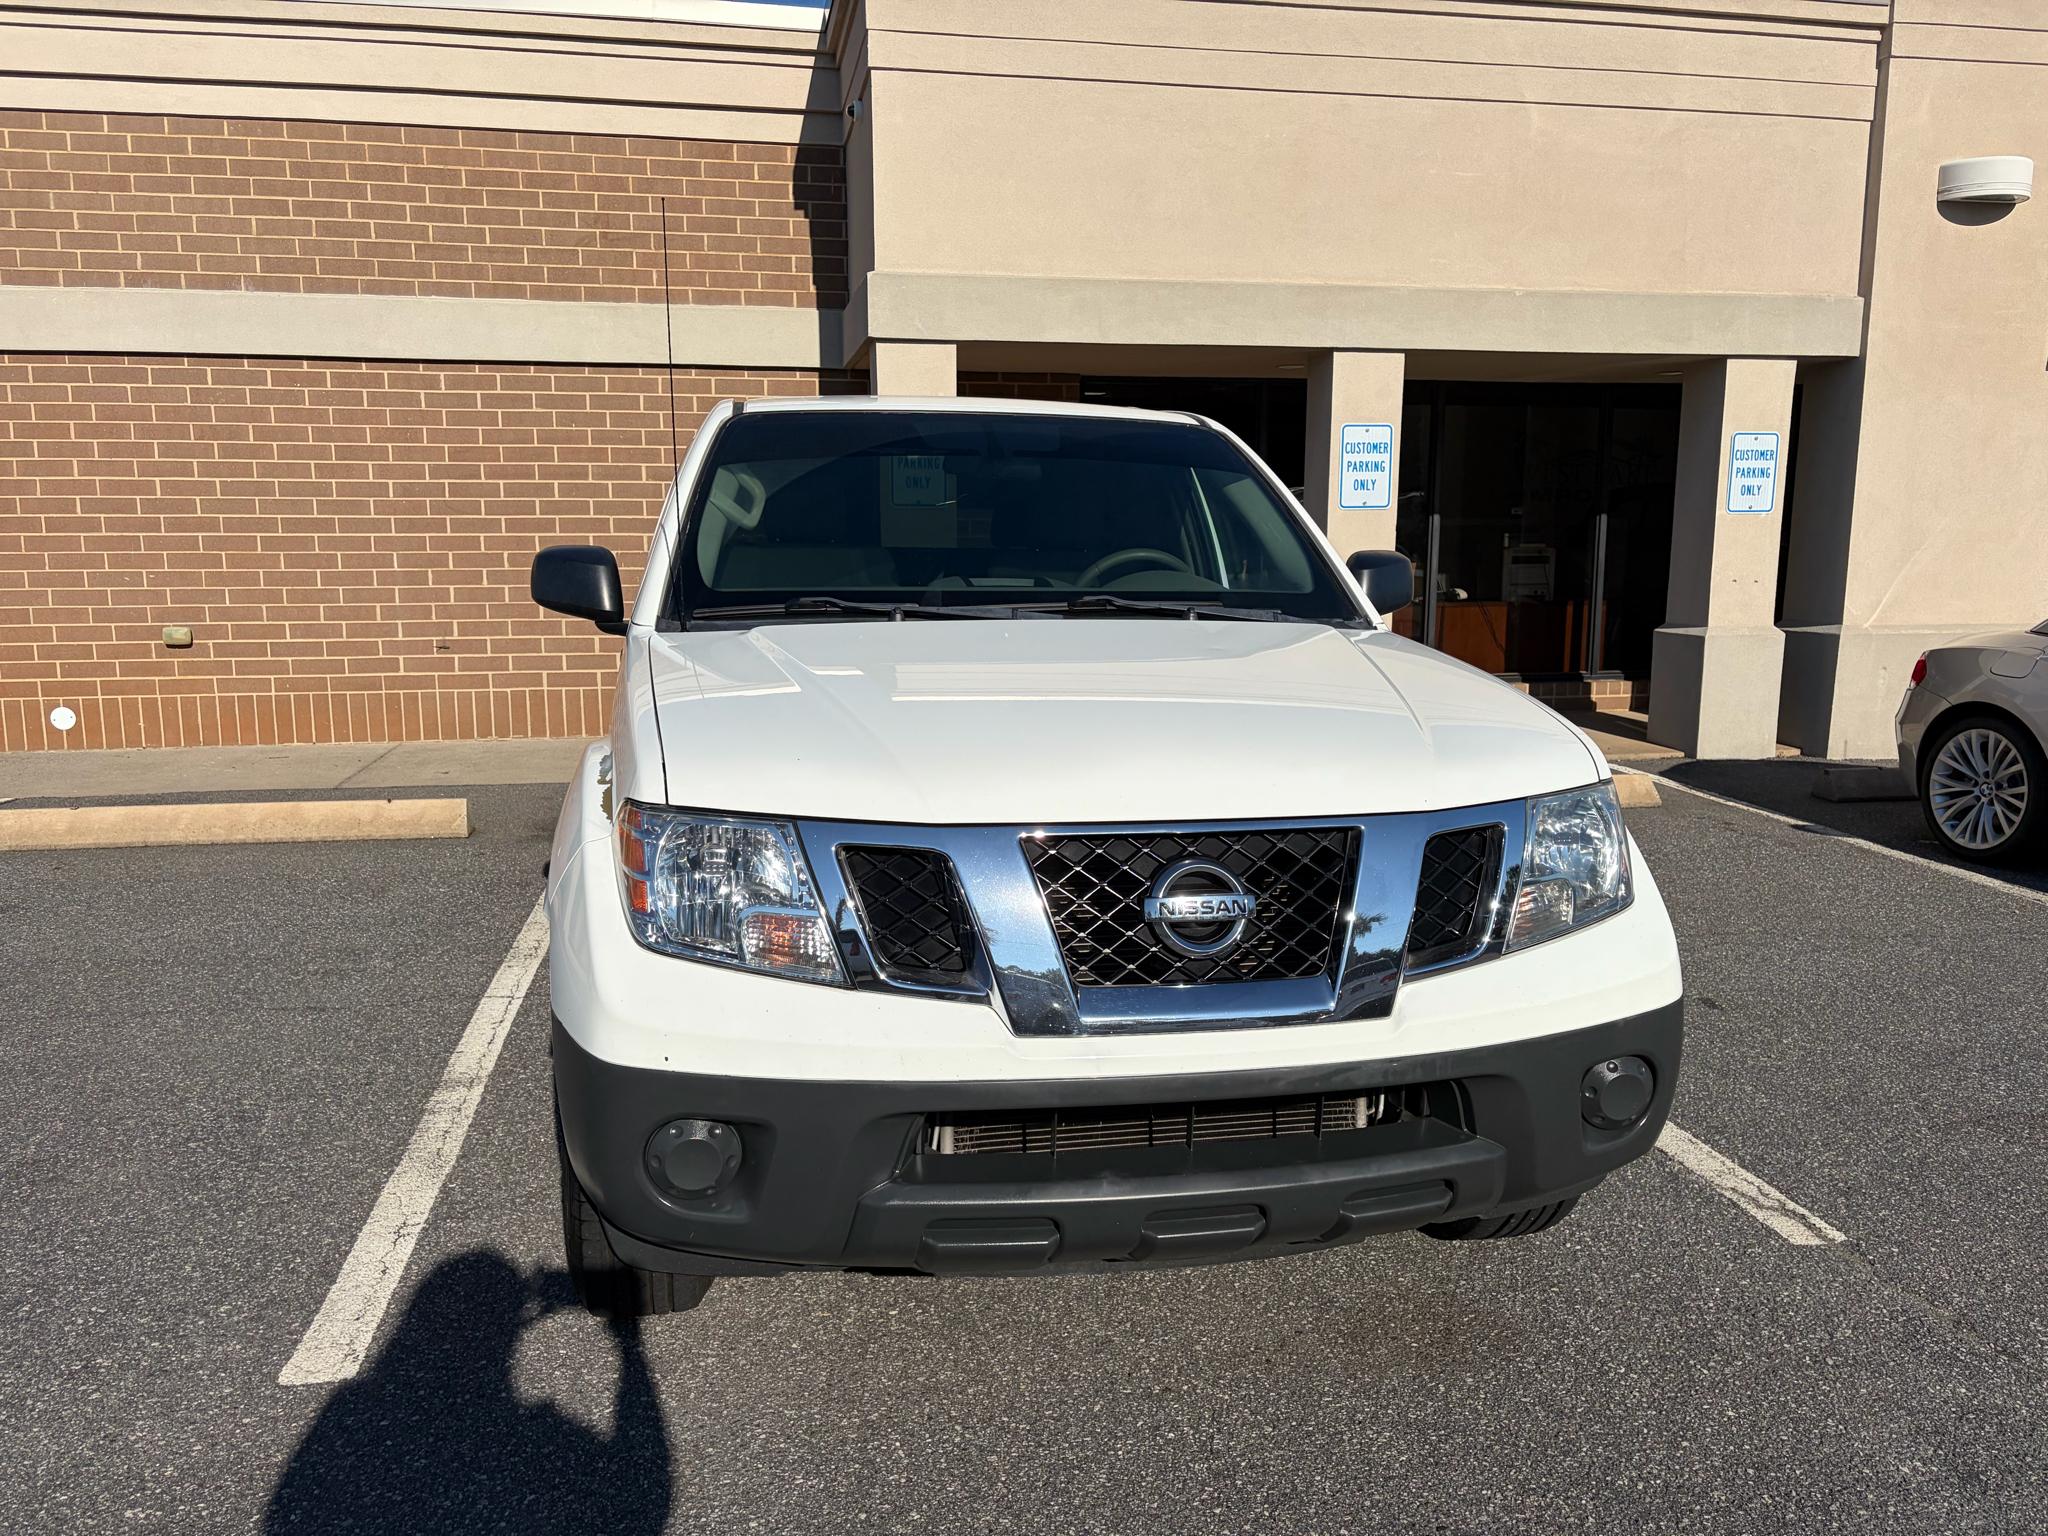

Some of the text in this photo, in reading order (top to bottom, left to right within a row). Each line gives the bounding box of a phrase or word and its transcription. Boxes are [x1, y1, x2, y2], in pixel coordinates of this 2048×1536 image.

[1345, 442, 1389, 454] CUSTOMER
[1735, 449, 1775, 461] CUSTOMER
[1347, 460, 1386, 472] PARKING
[1735, 467, 1771, 479] PARKING
[905, 476, 931, 488] ONLY
[1353, 479, 1377, 491] ONLY
[1740, 484, 1762, 496] ONLY
[1158, 899, 1248, 917] NISSAN
